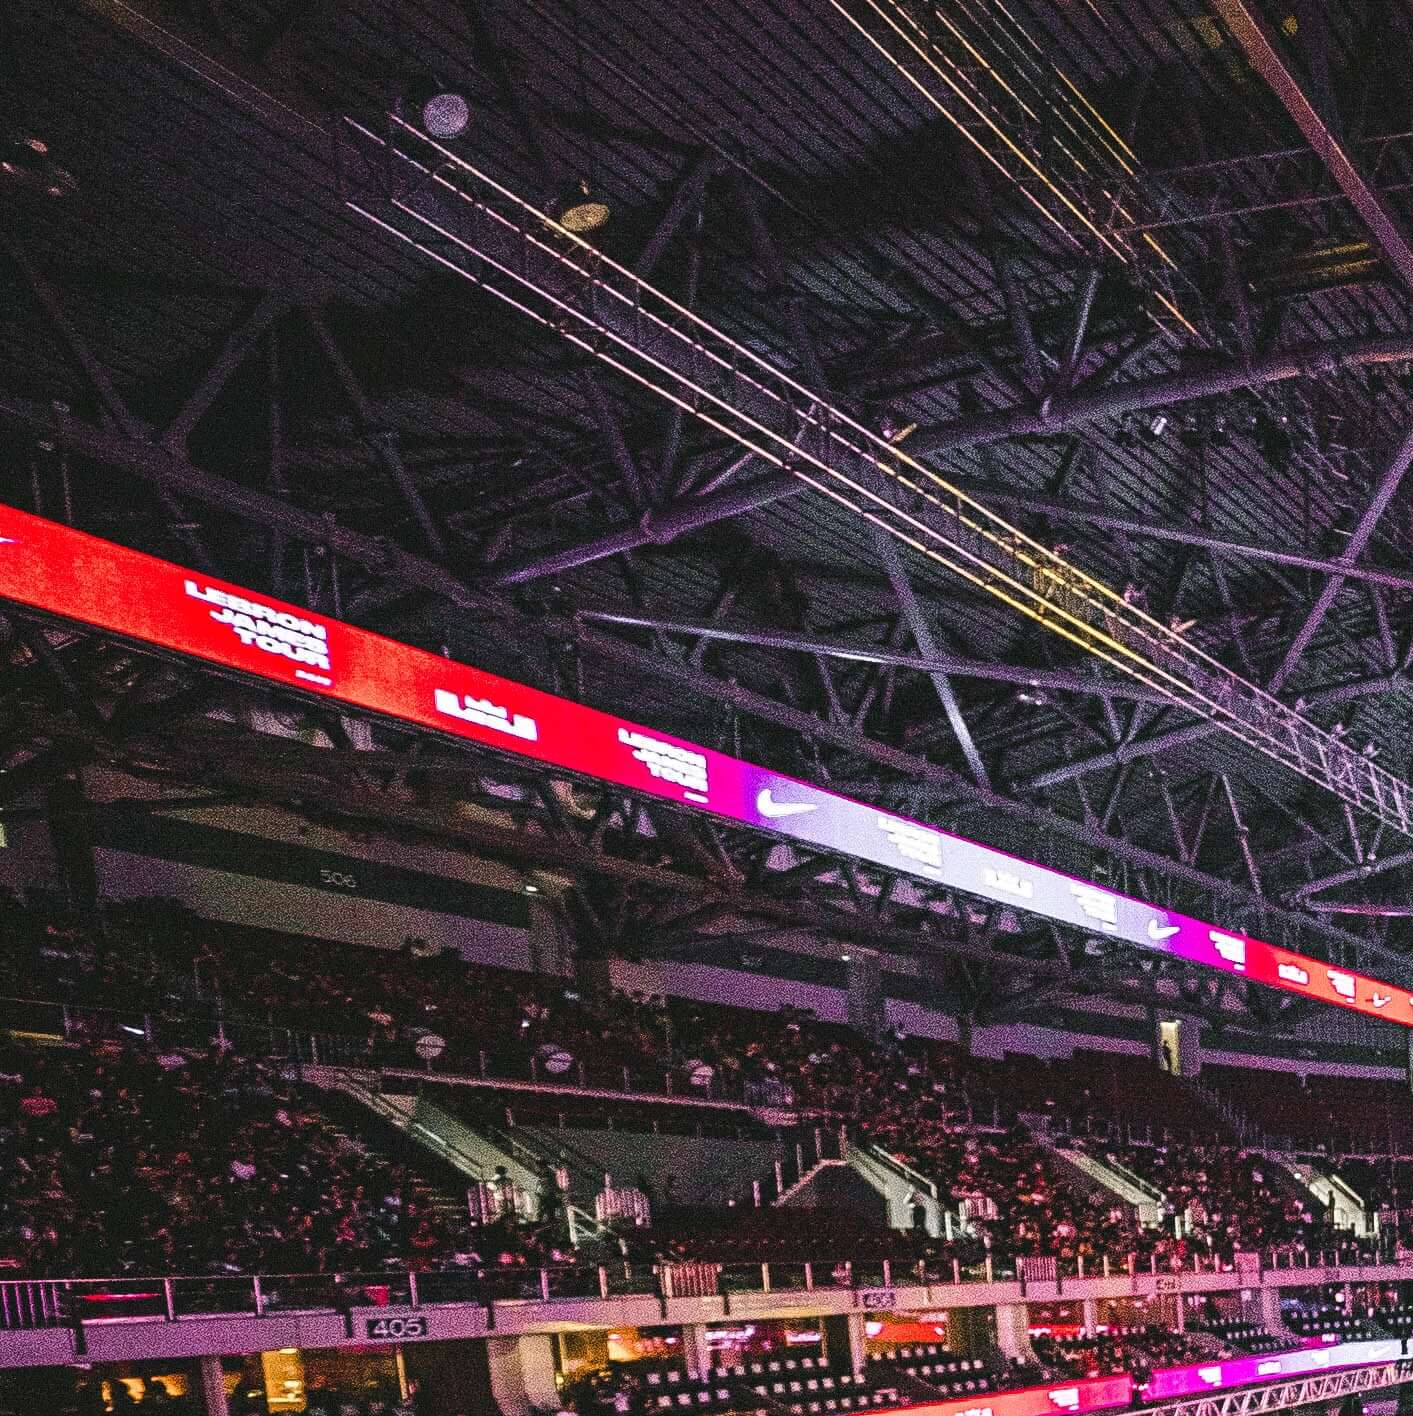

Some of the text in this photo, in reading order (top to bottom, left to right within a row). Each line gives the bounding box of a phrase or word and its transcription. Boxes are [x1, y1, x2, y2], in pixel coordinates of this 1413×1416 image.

[184, 580, 327, 640] LEBRON
[209, 608, 329, 655] JAMES
[233, 626, 331, 670] TOUR
[373, 1319, 424, 1337] 405
